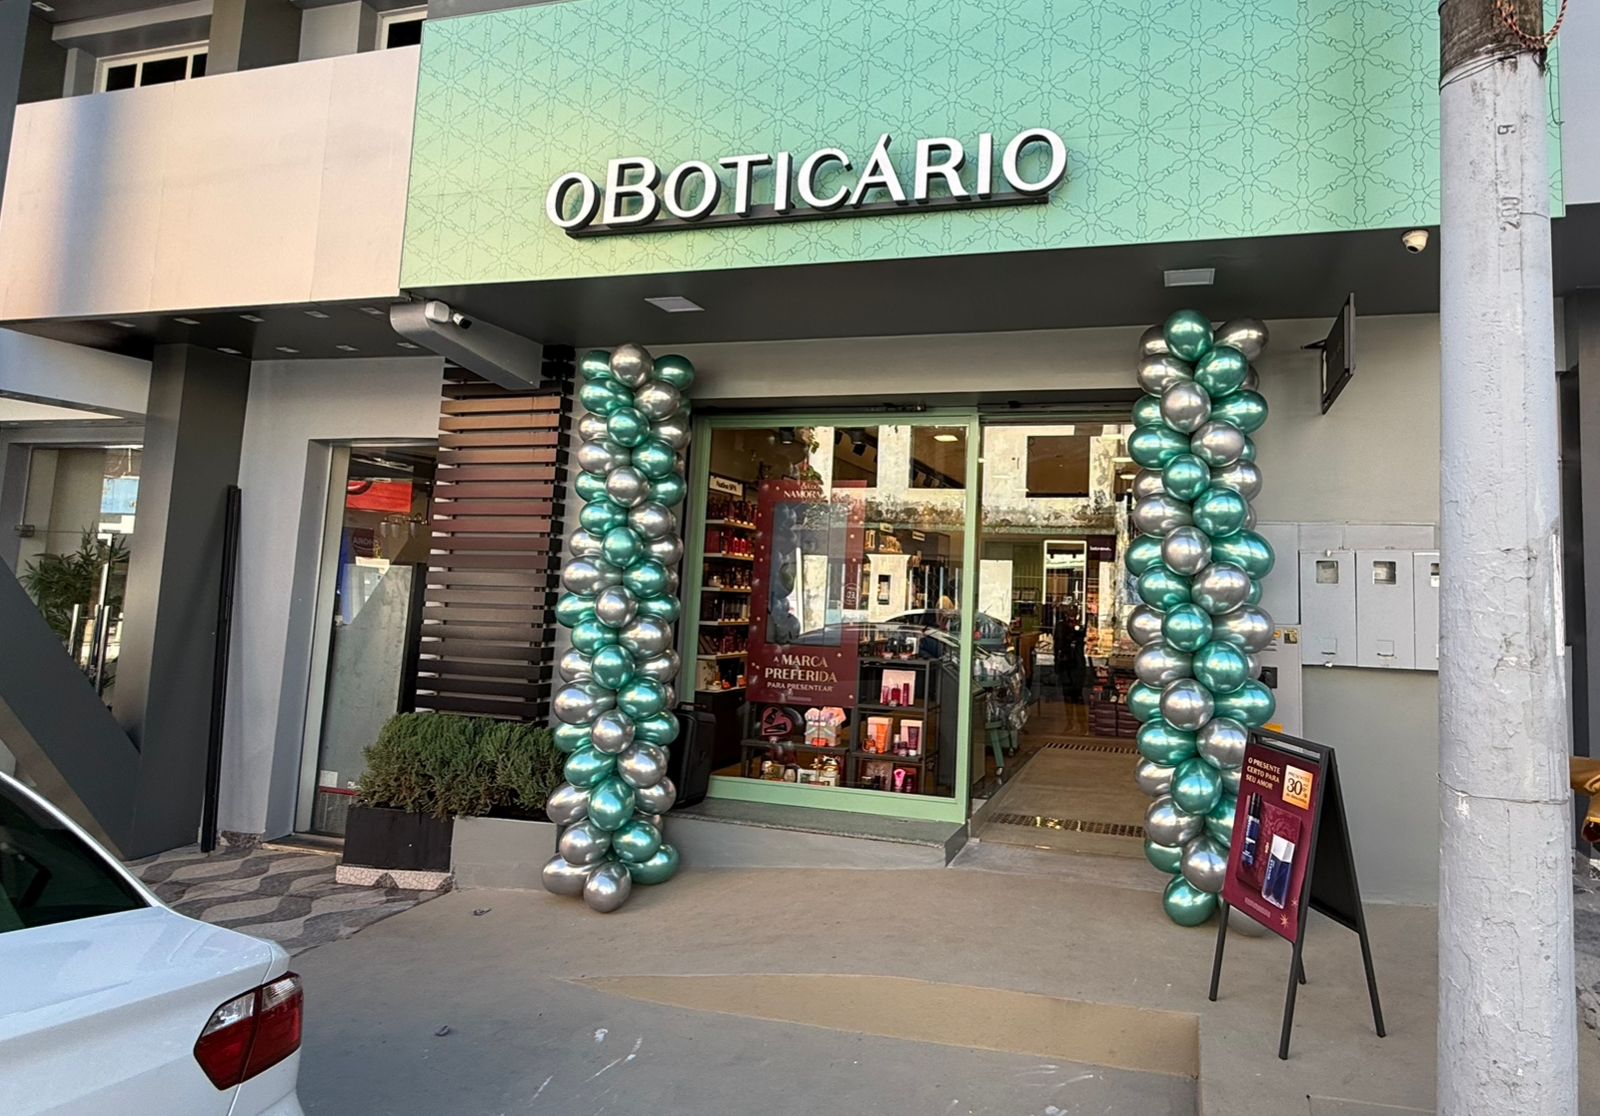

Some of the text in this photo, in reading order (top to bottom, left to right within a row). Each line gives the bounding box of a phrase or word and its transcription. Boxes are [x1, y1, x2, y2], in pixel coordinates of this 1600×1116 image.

[781, 654, 828, 668] MARCA
[765, 667, 838, 683] PREFERIDA
[787, 682, 834, 692] PRESENTEAR
[1246, 765, 1265, 778] CERTO
[1265, 772, 1280, 783] PARA
[1253, 759, 1281, 775] PRESENTE
[1245, 774, 1273, 790] SEU AMOR
[1287, 778, 1303, 796] 30
